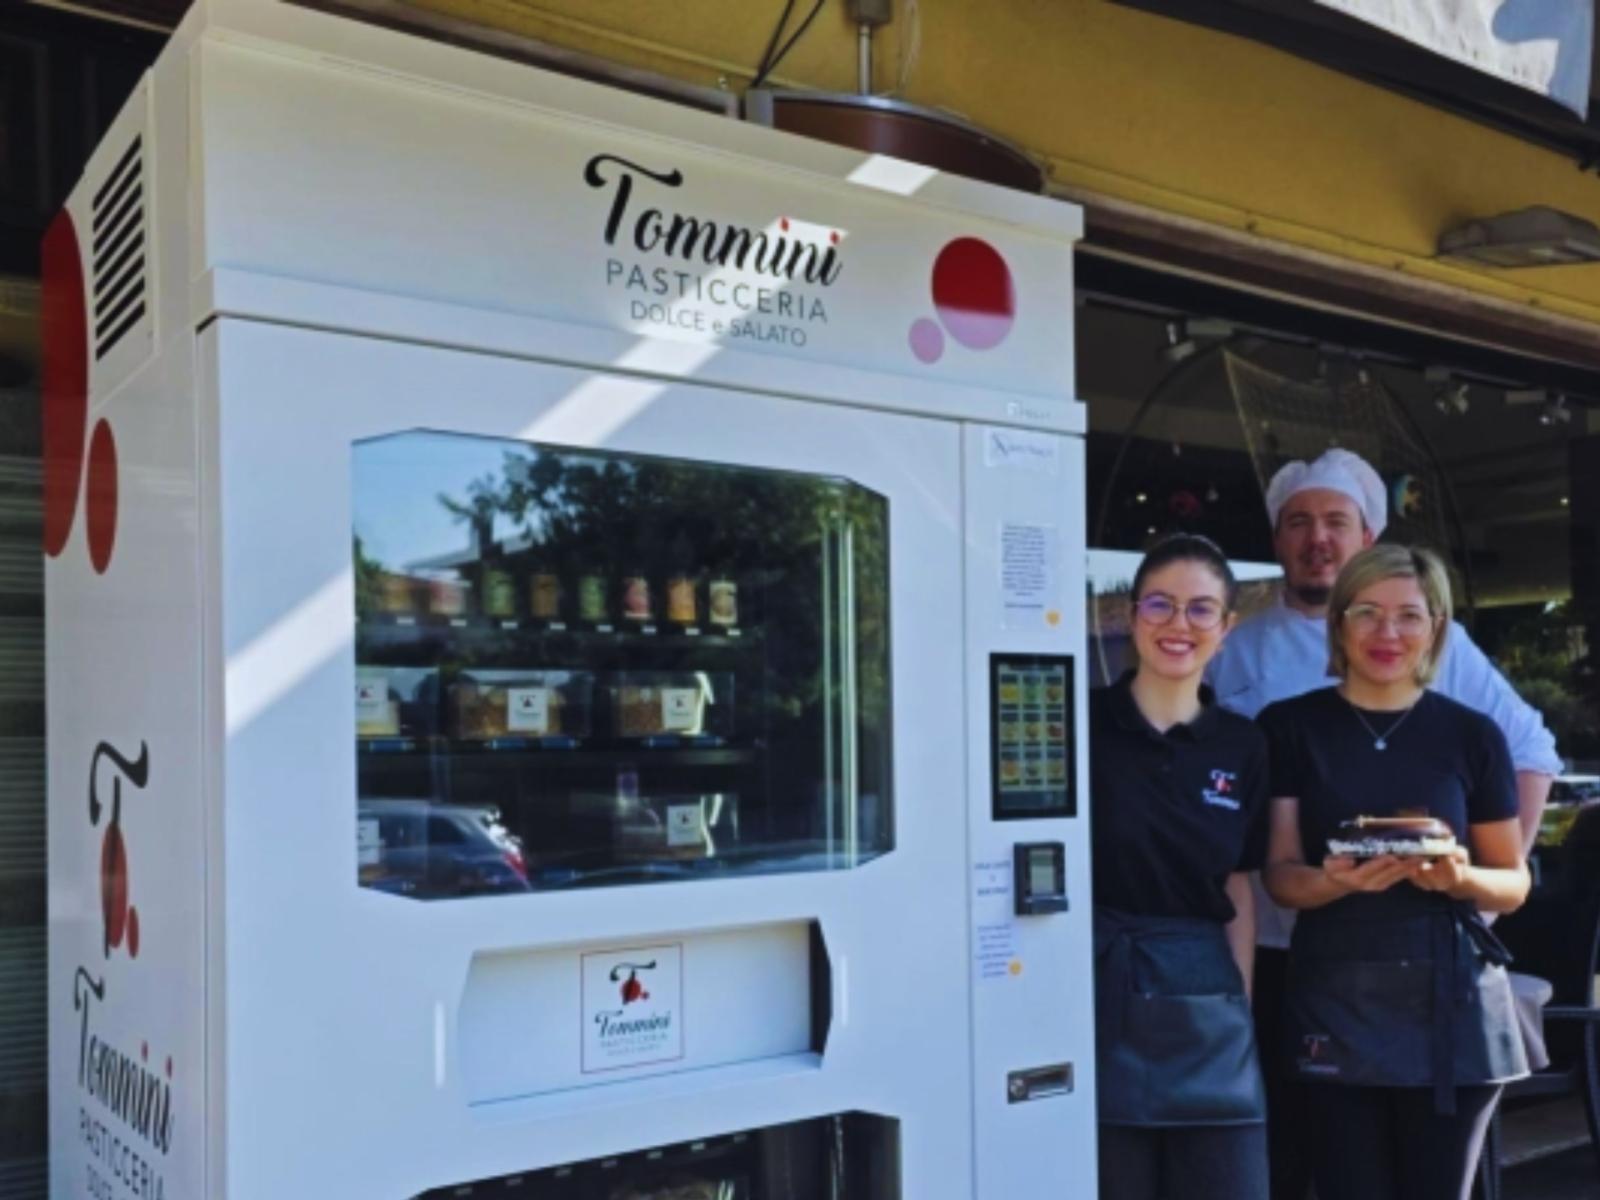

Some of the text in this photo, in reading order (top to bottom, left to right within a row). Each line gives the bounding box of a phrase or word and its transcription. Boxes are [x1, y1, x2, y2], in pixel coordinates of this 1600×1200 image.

[584, 153, 843, 287] Tommini
[605, 258, 829, 324] PASTICCERIA
[630, 299, 706, 333] DOLCE
[729, 315, 808, 348] SALATO
[74, 965, 175, 1155] Tommini
